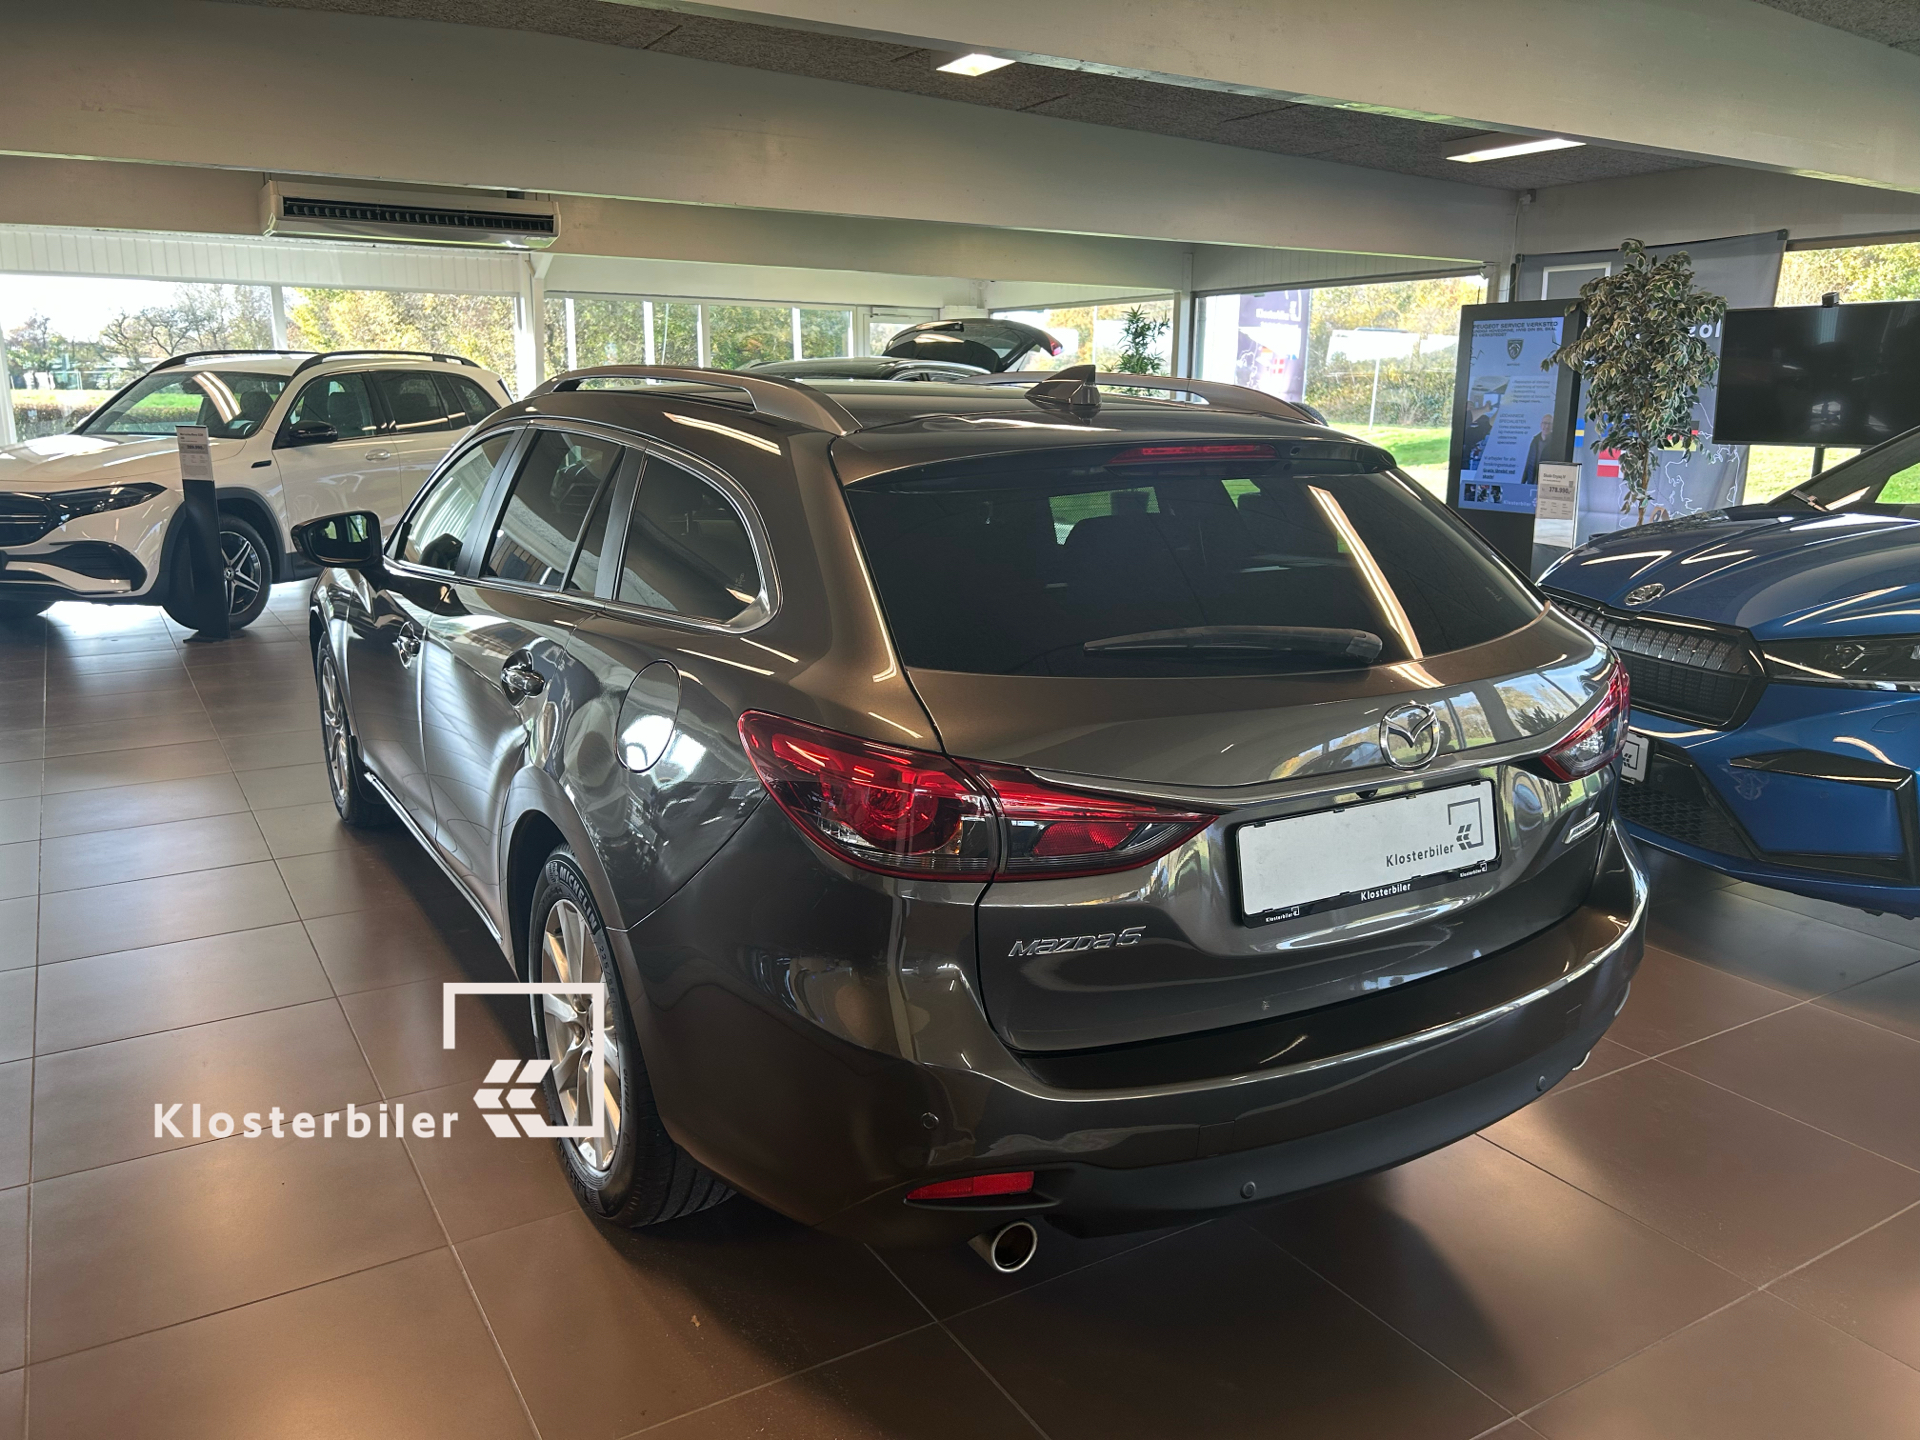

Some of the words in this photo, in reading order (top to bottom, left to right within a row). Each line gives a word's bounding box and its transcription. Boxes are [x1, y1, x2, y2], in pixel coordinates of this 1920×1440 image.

[1386, 843, 1454, 867] Klosterbiler
[559, 866, 598, 930] MICHELIN
[1360, 883, 1411, 901] Klosterbiler
